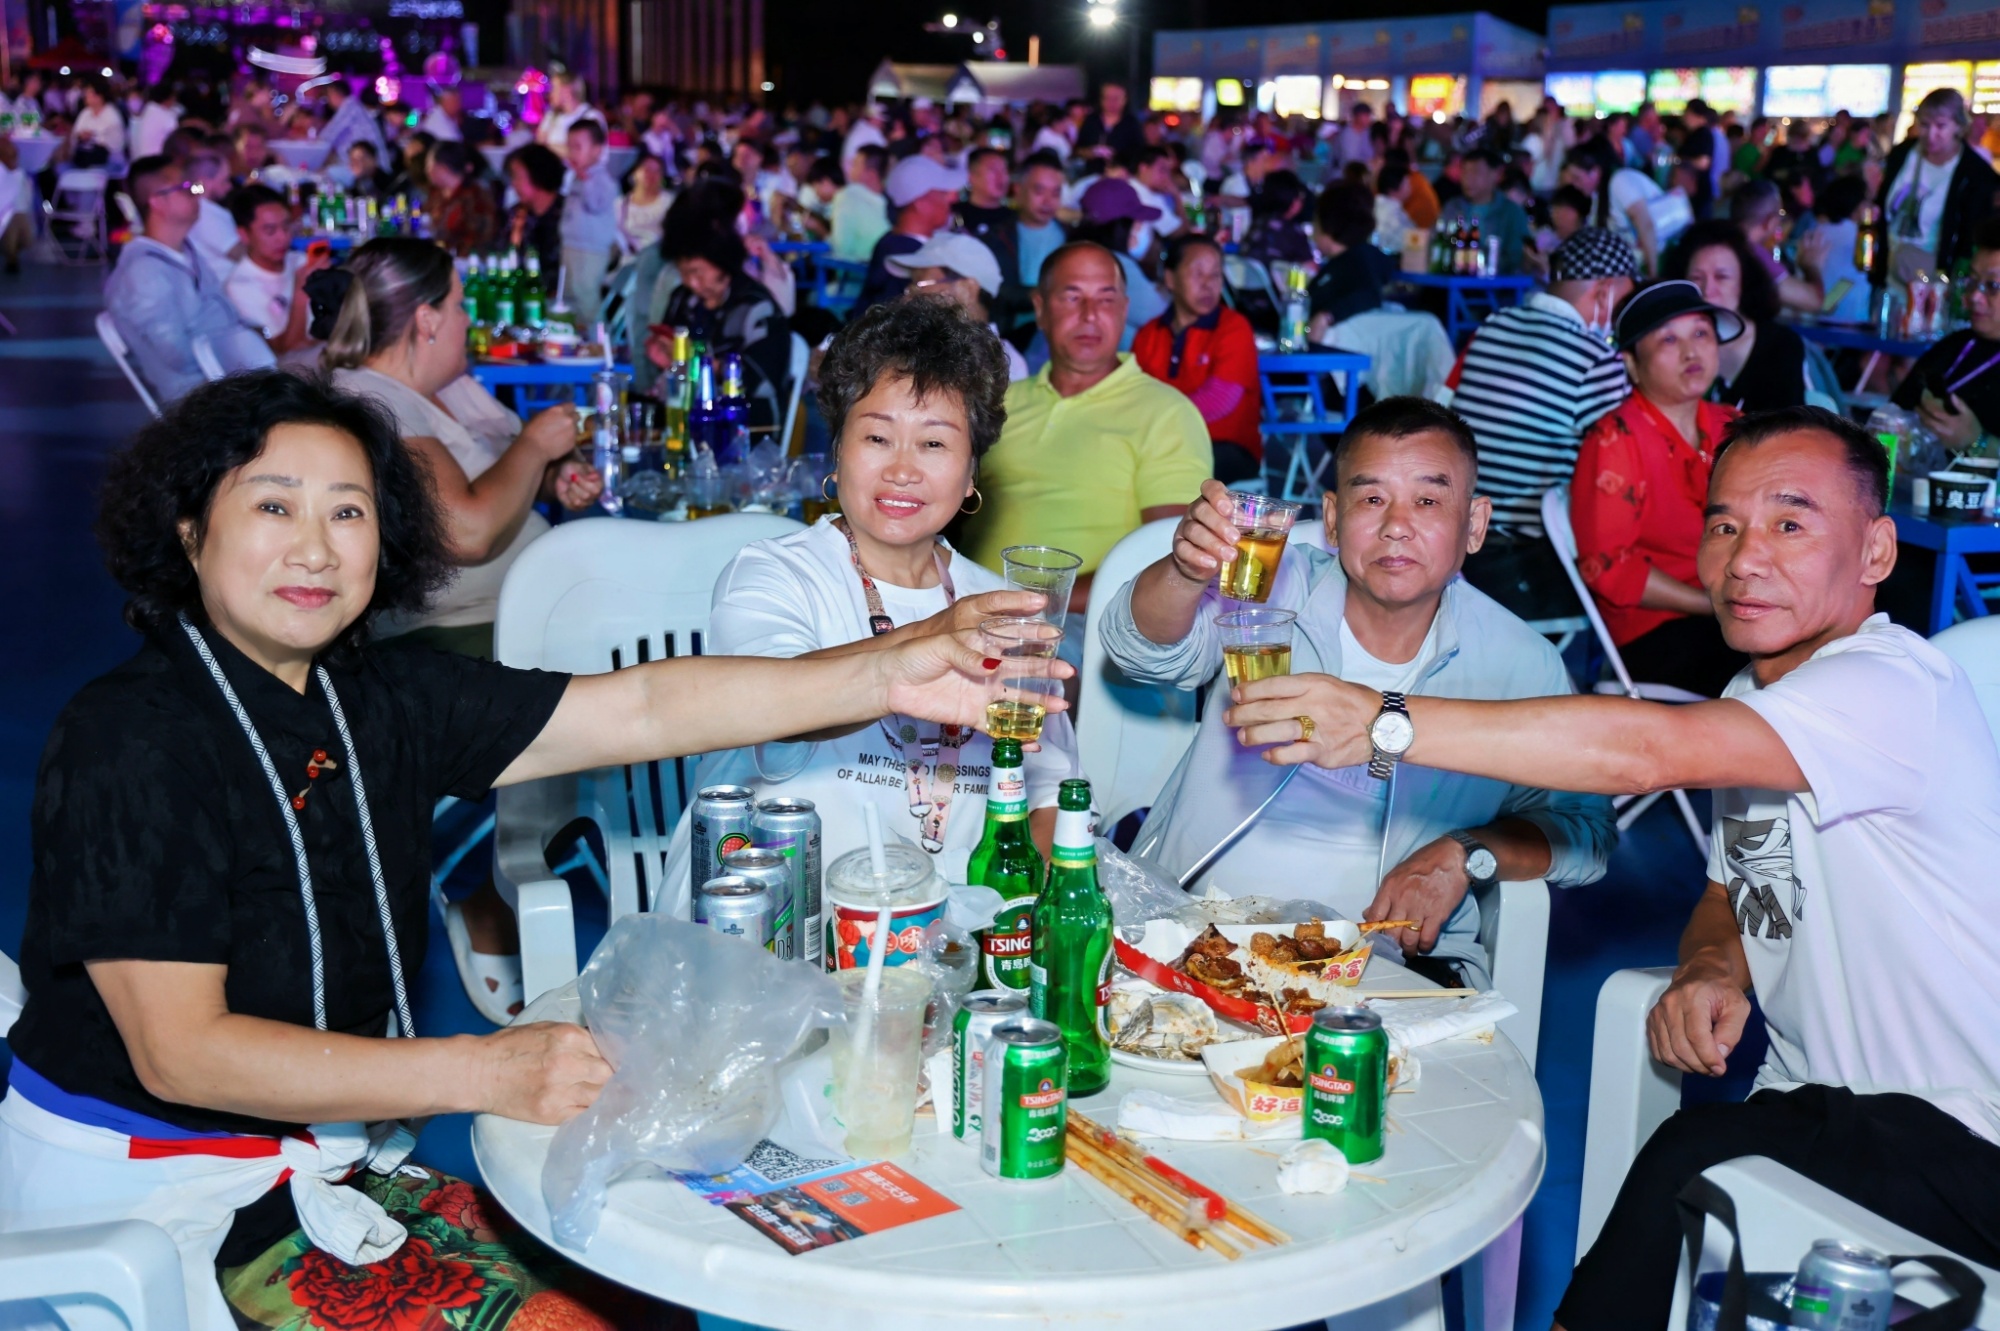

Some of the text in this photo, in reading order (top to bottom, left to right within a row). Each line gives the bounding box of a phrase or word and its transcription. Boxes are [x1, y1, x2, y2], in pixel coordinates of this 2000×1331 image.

[858, 752, 881, 767] MAY
[837, 768, 854, 780] OF
[855, 771, 888, 786] ALLAH
[888, 776, 903, 788] BE
[964, 783, 989, 795] FAMIL
[988, 936, 1031, 953] TSING
[1001, 957, 1031, 972] 青岛
[952, 1030, 962, 1128] TSINGTAO
[1311, 1074, 1352, 1092] TSINGTAO
[1023, 1090, 1063, 1106] TSINGTAO
[1252, 1096, 1301, 1113] 好运
